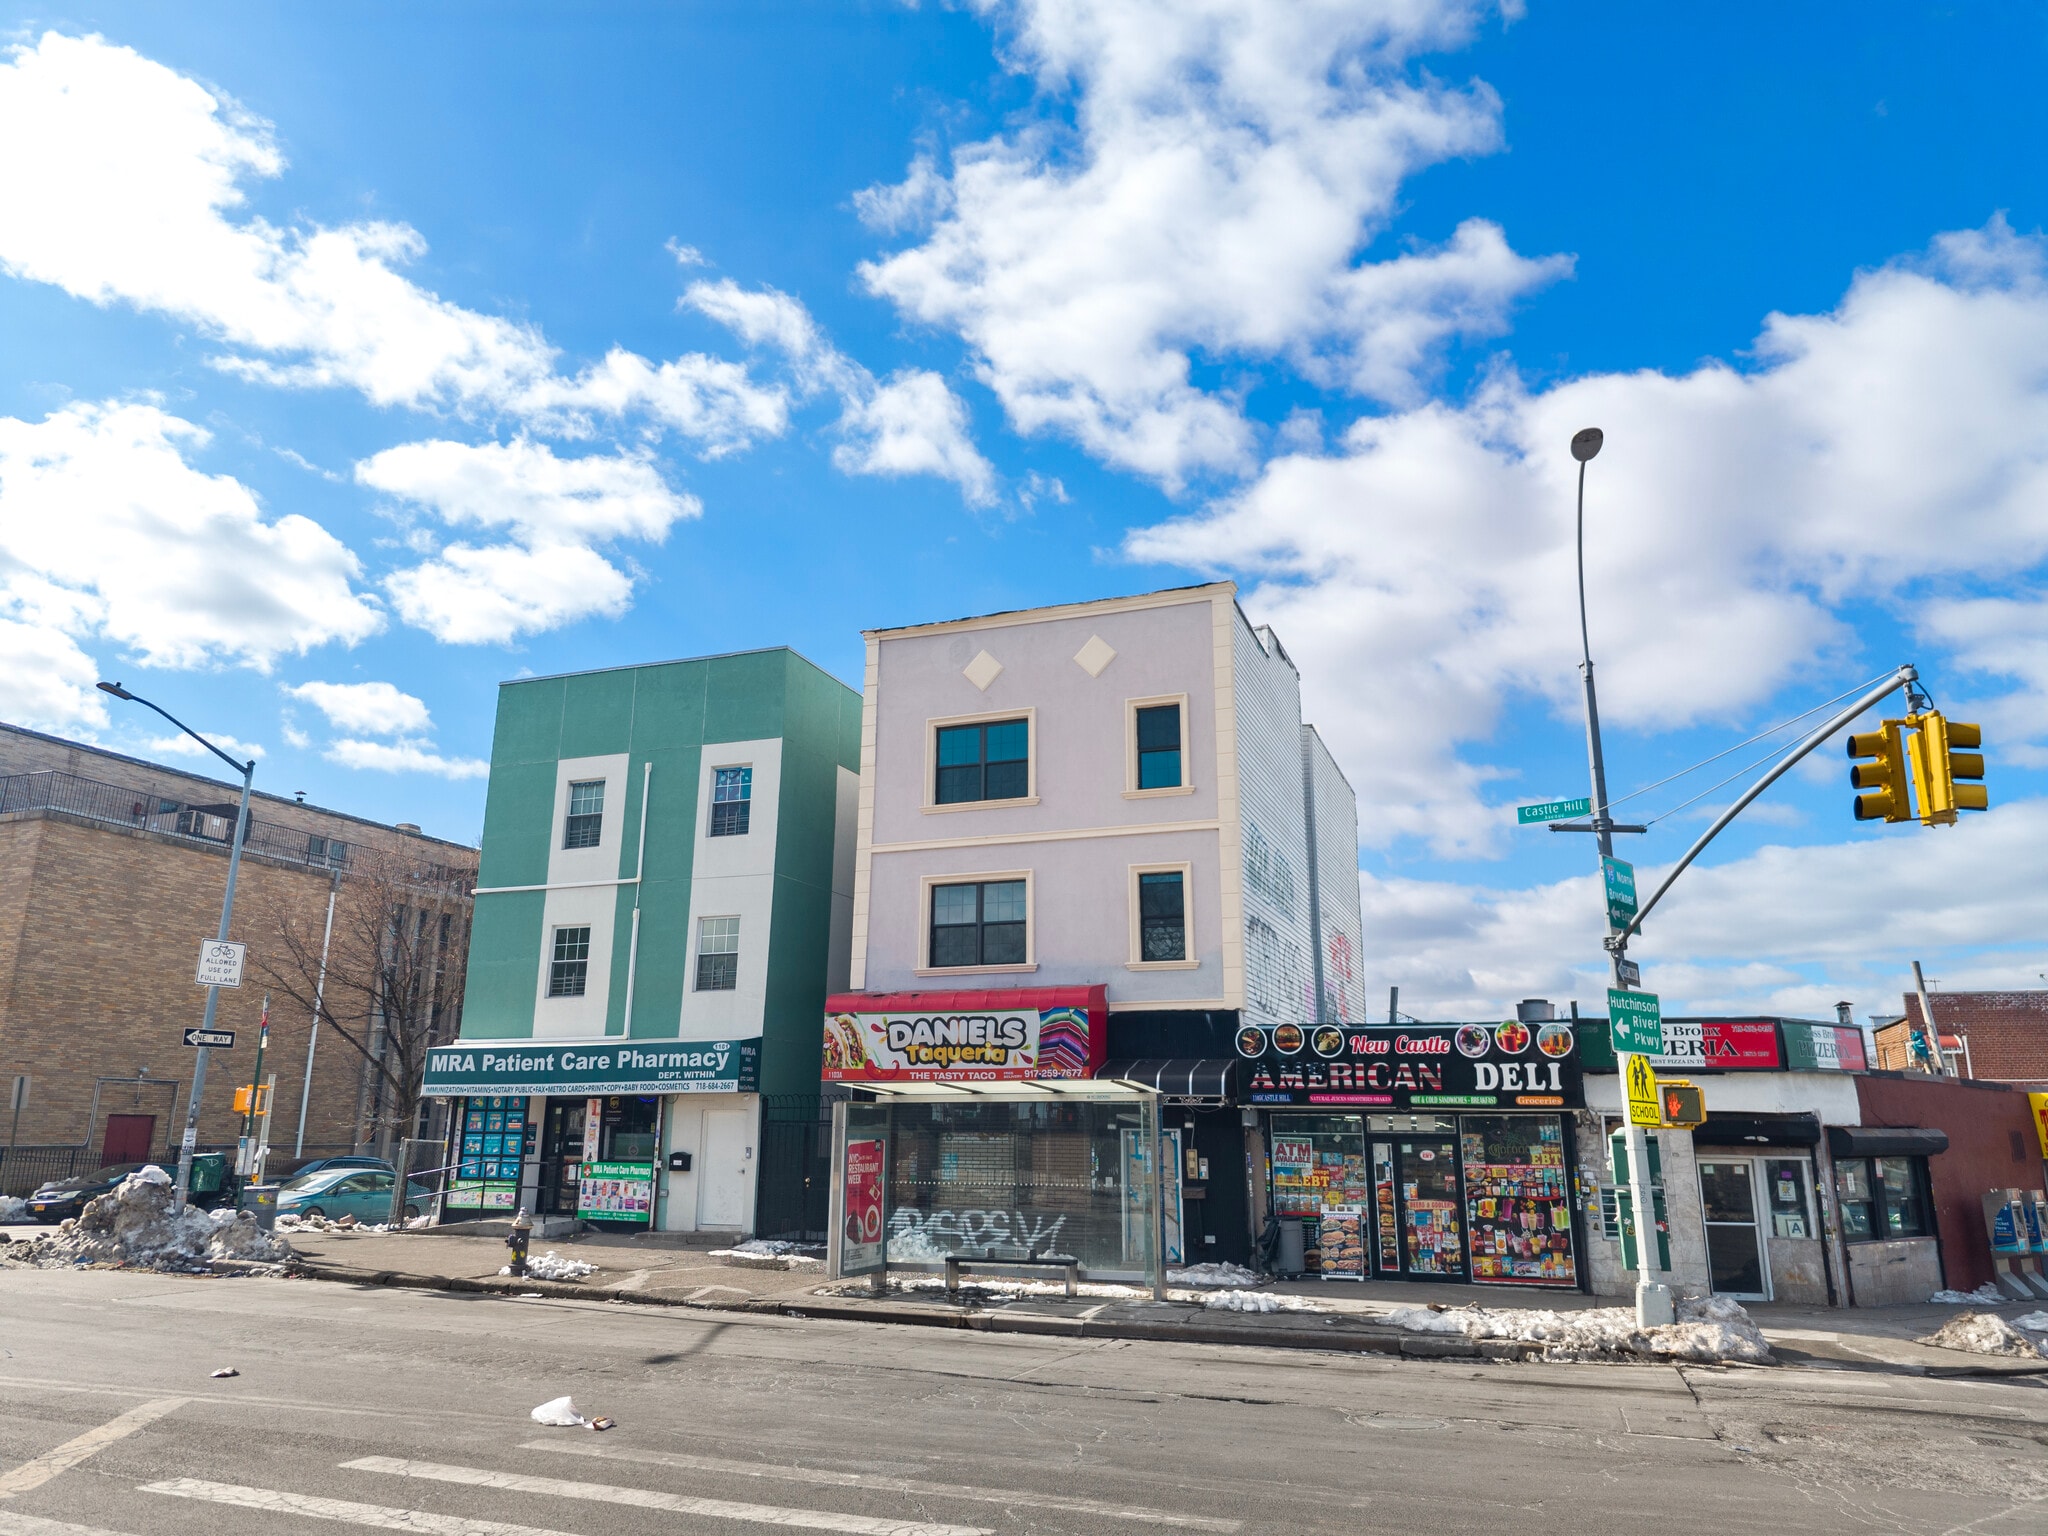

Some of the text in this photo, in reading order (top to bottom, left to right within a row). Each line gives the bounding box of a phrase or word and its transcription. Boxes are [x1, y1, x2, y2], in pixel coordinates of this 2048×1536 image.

[1525, 801, 1583, 817] Castle Hill
[1608, 887, 1634, 906] Bruckner
[206, 958, 238, 967] ALLOWED
[219, 976, 238, 984] LANE
[1610, 995, 1658, 1013] Hutchinson
[1632, 1015, 1658, 1030] River
[888, 1017, 1025, 1050] DANIELS
[1673, 1026, 1721, 1037] Bronx
[191, 1034, 229, 1043] ONE WAY
[1350, 1034, 1451, 1054] New Castle
[1634, 1032, 1660, 1050] Pkwy
[741, 1046, 757, 1056] MRA
[905, 1041, 1006, 1066] Taqueria
[1797, 1040, 1850, 1059] PIZZERIA
[431, 1049, 730, 1072] MRA Patient Care Pharmacy
[658, 1071, 715, 1079] DEPT. WITHIN
[909, 1071, 996, 1080] THE TASTY TACO
[1024, 1068, 1082, 1078] 917-259-7677
[1250, 1061, 1563, 1091] AMERICAN DELI
[547, 1085, 567, 1093] METRO
[568, 1084, 586, 1092] CARDS
[624, 1083, 638, 1091] BABY
[640, 1083, 656, 1091] FOOD
[658, 1082, 690, 1091] COSMETICS
[696, 1081, 734, 1090] 718-684-2667
[1411, 1096, 1420, 1104] HOT
[1426, 1096, 1438, 1104] COLD
[1439, 1096, 1467, 1104] SANDWICHES
[1471, 1096, 1497, 1105] BREAKFAST
[1517, 1096, 1562, 1104] Groceries
[1631, 1105, 1659, 1119] SCHOOL
[1275, 1142, 1310, 1156] ATM
[849, 1153, 860, 1164] NYC
[1531, 1153, 1561, 1165] EBT
[592, 1165, 650, 1177] MRA Patient Care Pharmacy
[848, 1162, 879, 1174] RESTAURANT
[848, 1174, 862, 1185] WEEK
[1303, 1175, 1330, 1187] EBT
[1792, 1222, 1802, 1234] A
